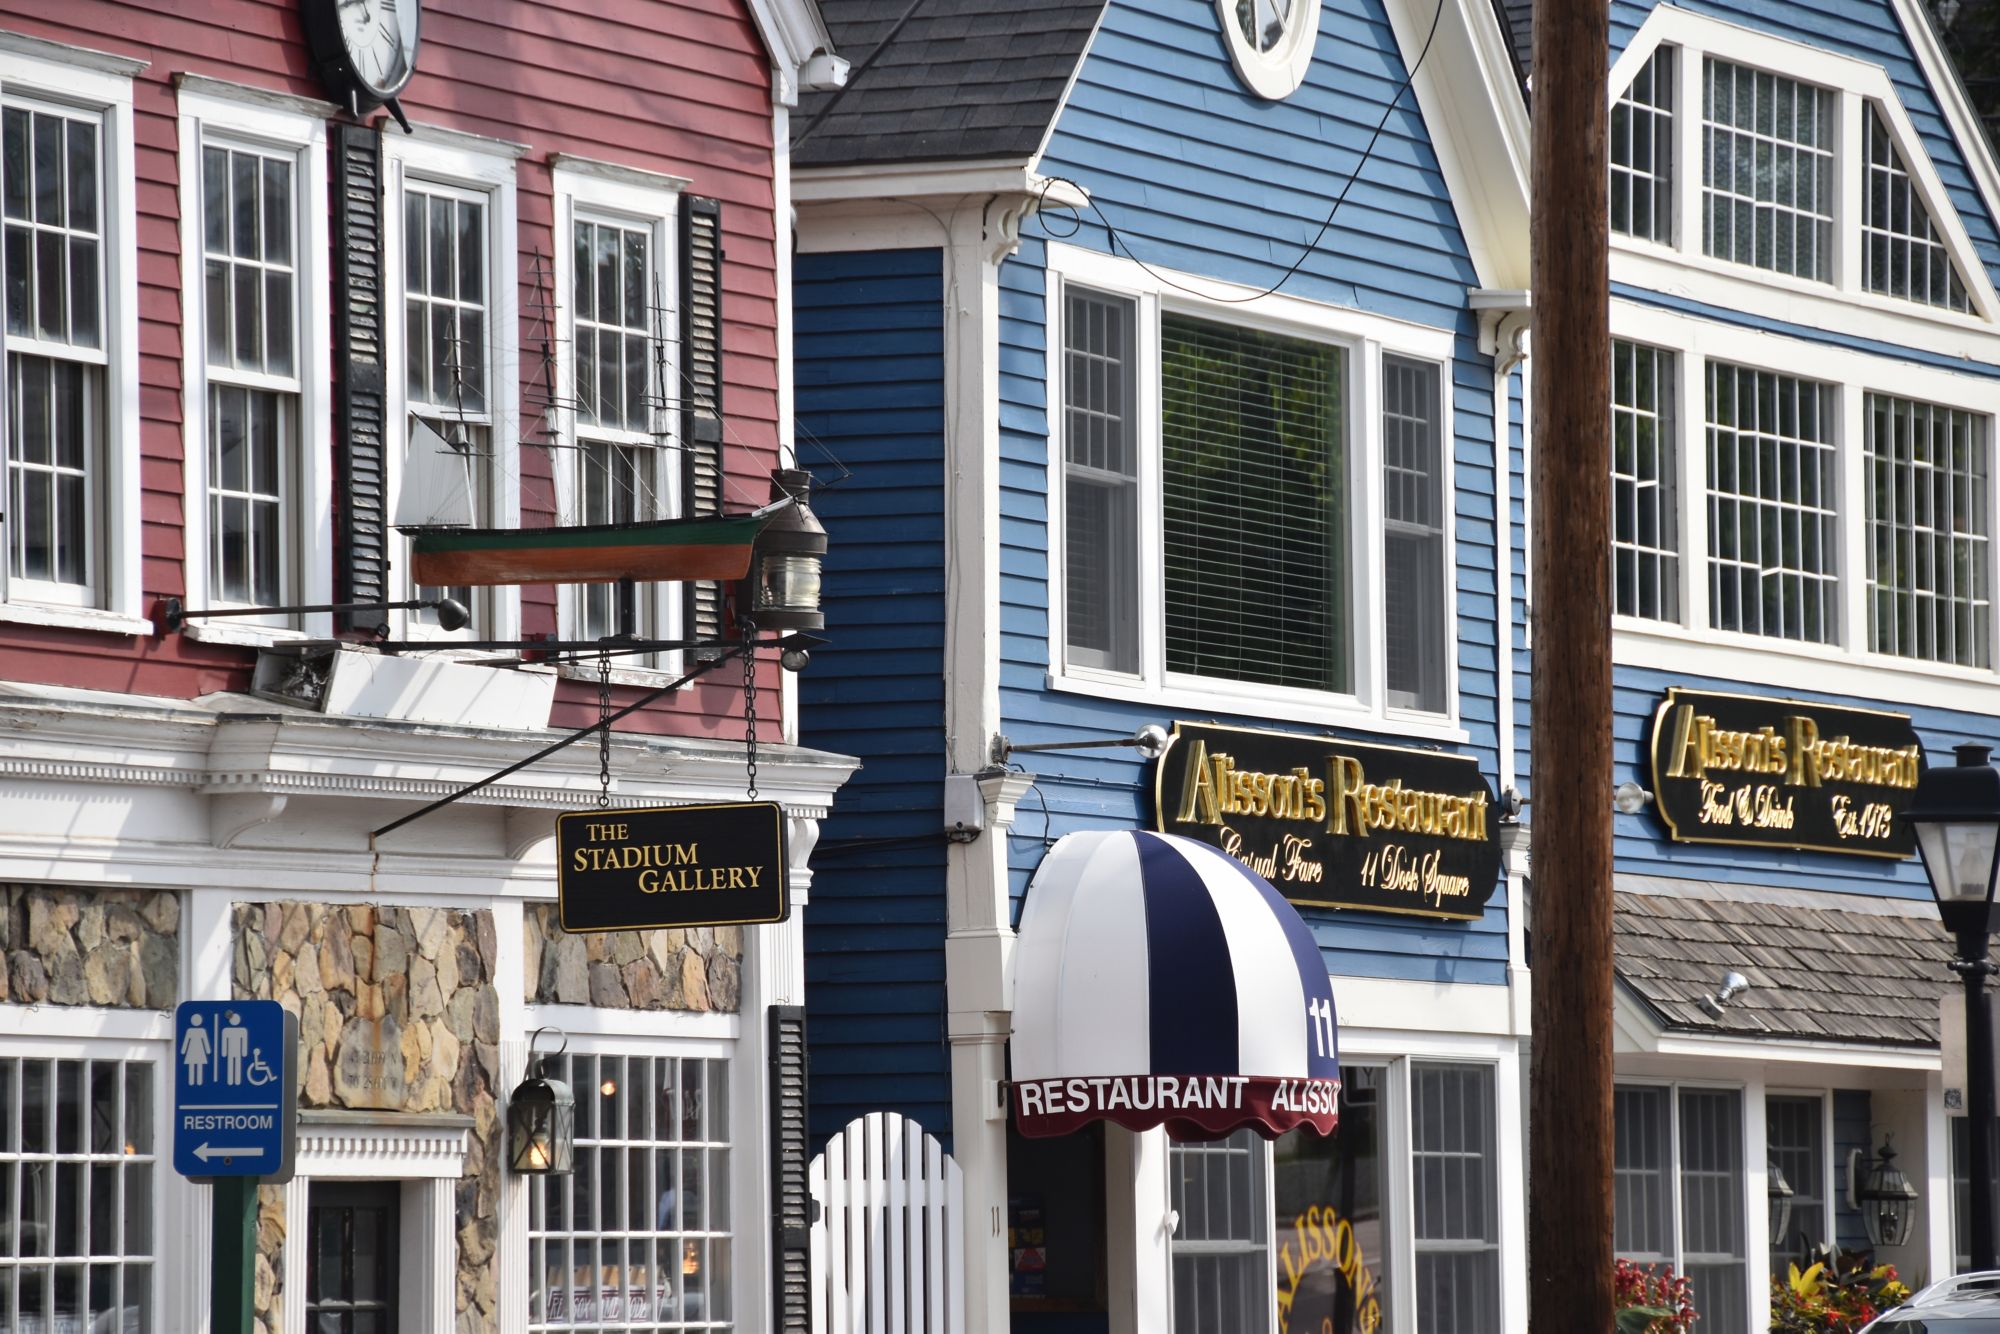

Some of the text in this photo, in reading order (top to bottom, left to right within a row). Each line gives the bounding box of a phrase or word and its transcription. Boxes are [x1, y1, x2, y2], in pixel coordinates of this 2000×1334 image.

[1665, 704, 1920, 789] Alisson's Restaurant
[1176, 739, 1488, 841] Alisson's Restaurant
[1698, 779, 1735, 825] Food
[1754, 784, 1794, 830] Drink
[573, 843, 698, 872] STADIUM
[586, 823, 630, 843] THE
[1281, 833, 1323, 883] Fare
[638, 866, 764, 893] GALLERY
[1360, 844, 1470, 907] 11 Dock Square
[1308, 997, 1335, 1059] 11
[1020, 1076, 1342, 1117] RESTAURANT ALISSO
[183, 1115, 273, 1130] RESTROOM
